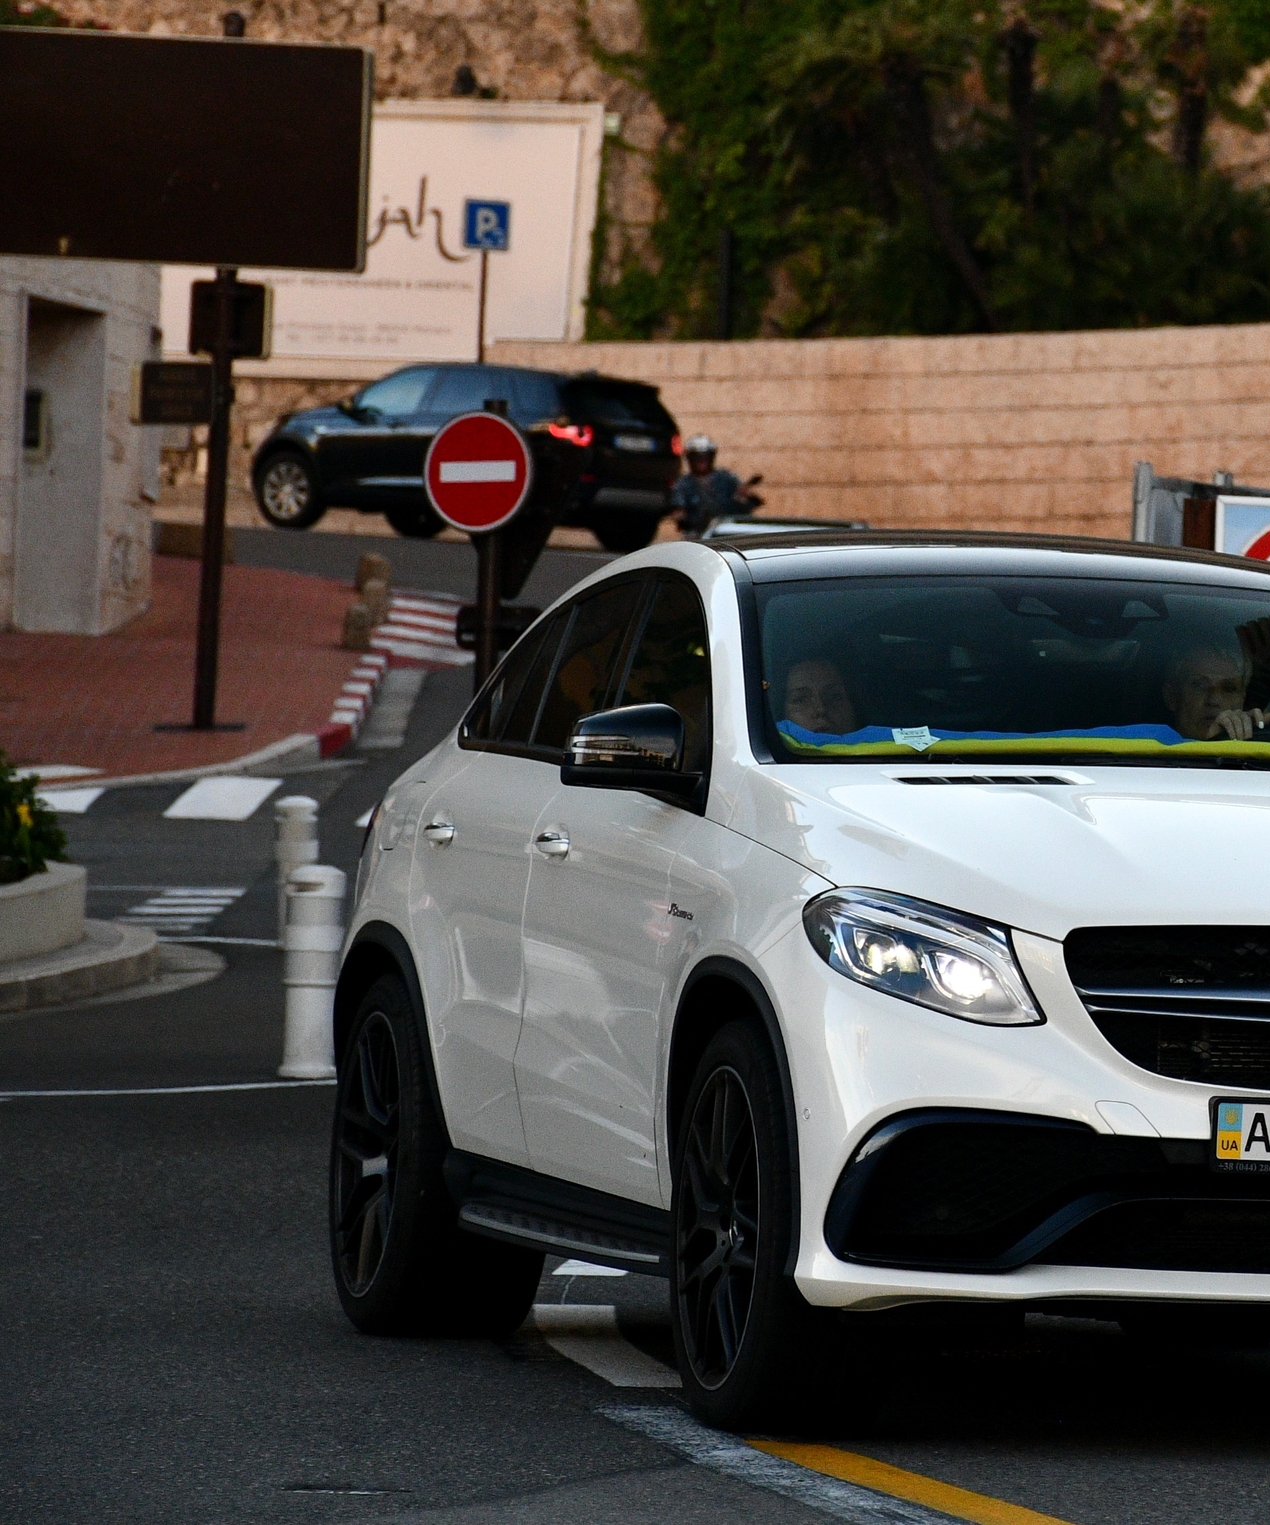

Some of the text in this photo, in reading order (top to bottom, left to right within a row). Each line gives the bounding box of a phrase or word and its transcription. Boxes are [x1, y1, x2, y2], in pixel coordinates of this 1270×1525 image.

[1221, 1139, 1239, 1151] UA
[1218, 1162, 1234, 1171] +38
[1235, 1162, 1257, 1172] (044)
